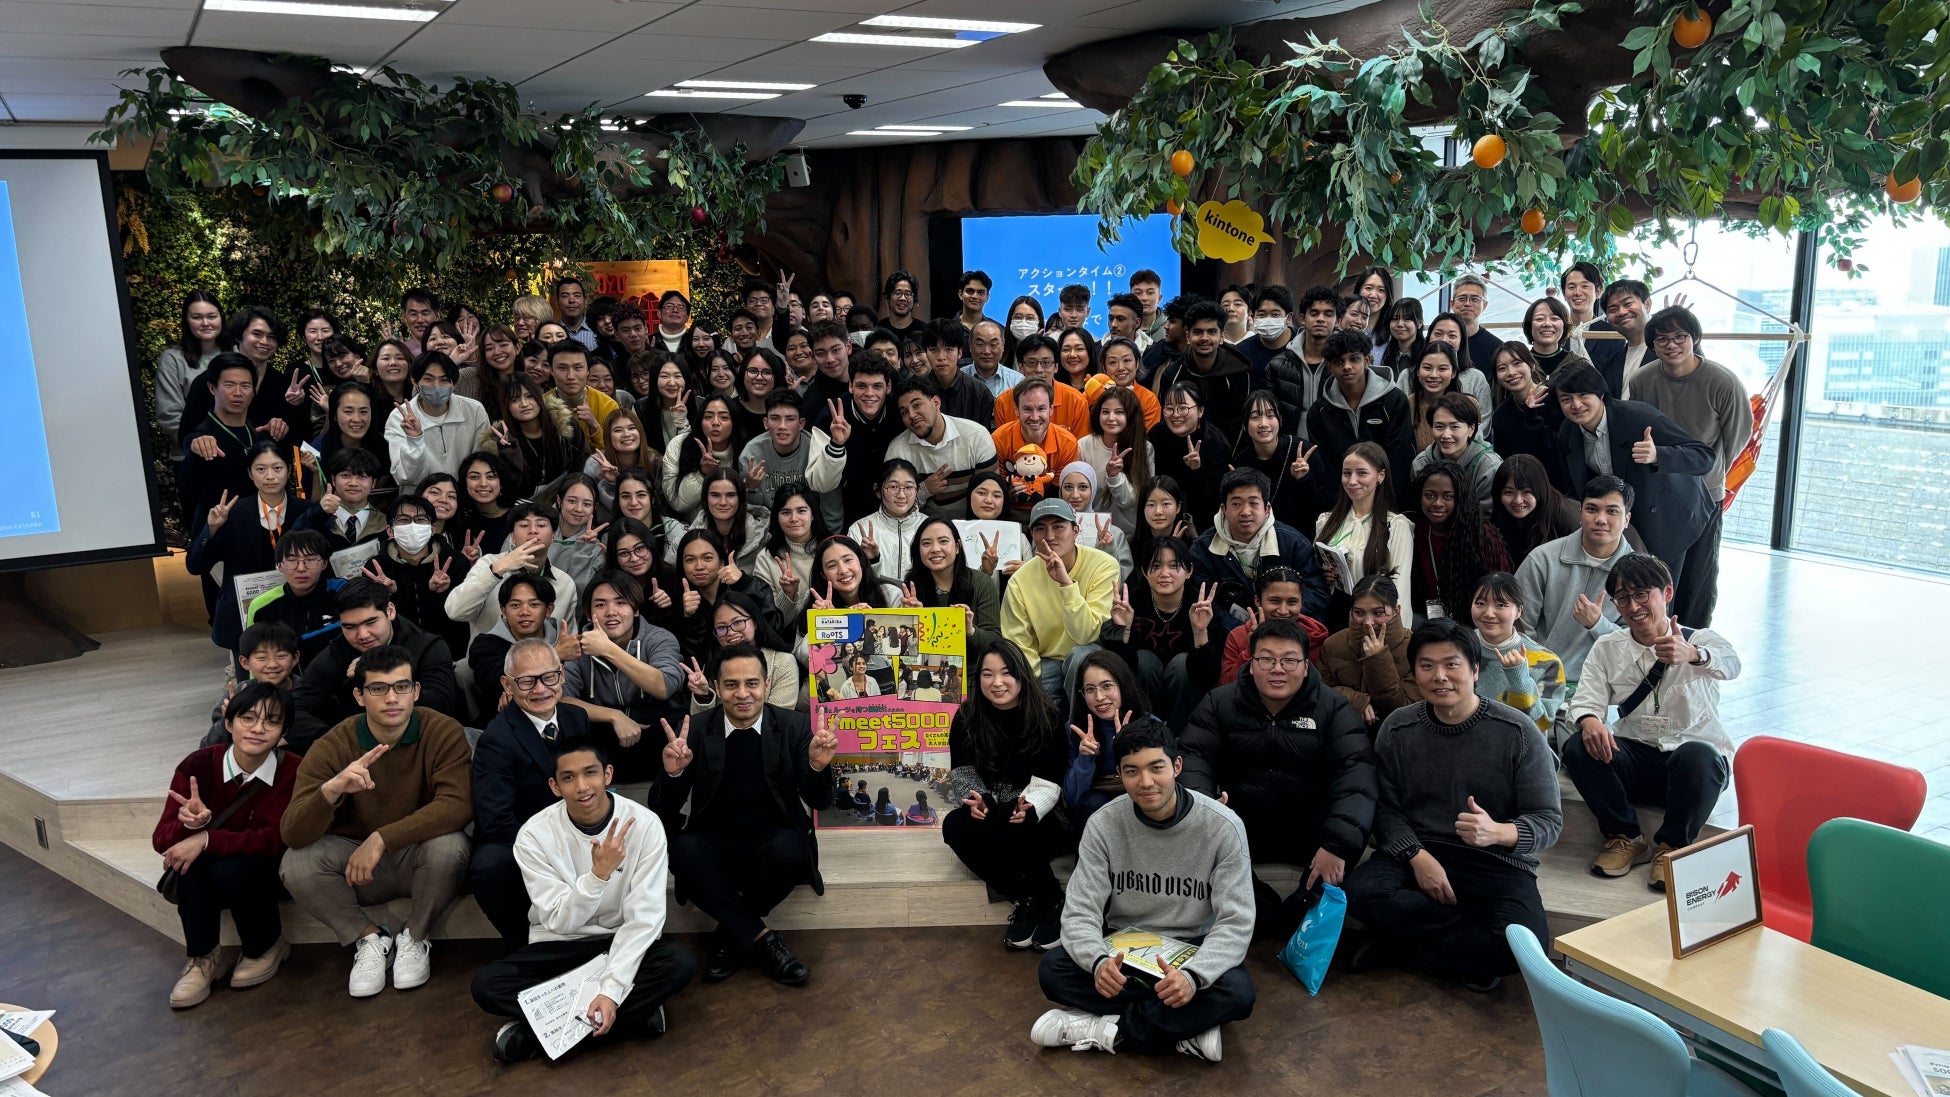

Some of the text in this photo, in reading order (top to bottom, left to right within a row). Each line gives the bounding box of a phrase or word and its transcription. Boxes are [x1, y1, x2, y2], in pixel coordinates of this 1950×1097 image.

[1204, 209, 1255, 246] kintone
[1018, 264, 1126, 279] アクションタイム②
[857, 729, 921, 751] フェス
[1685, 885, 1709, 899] BISON
[1686, 889, 1717, 906] ENERGY
